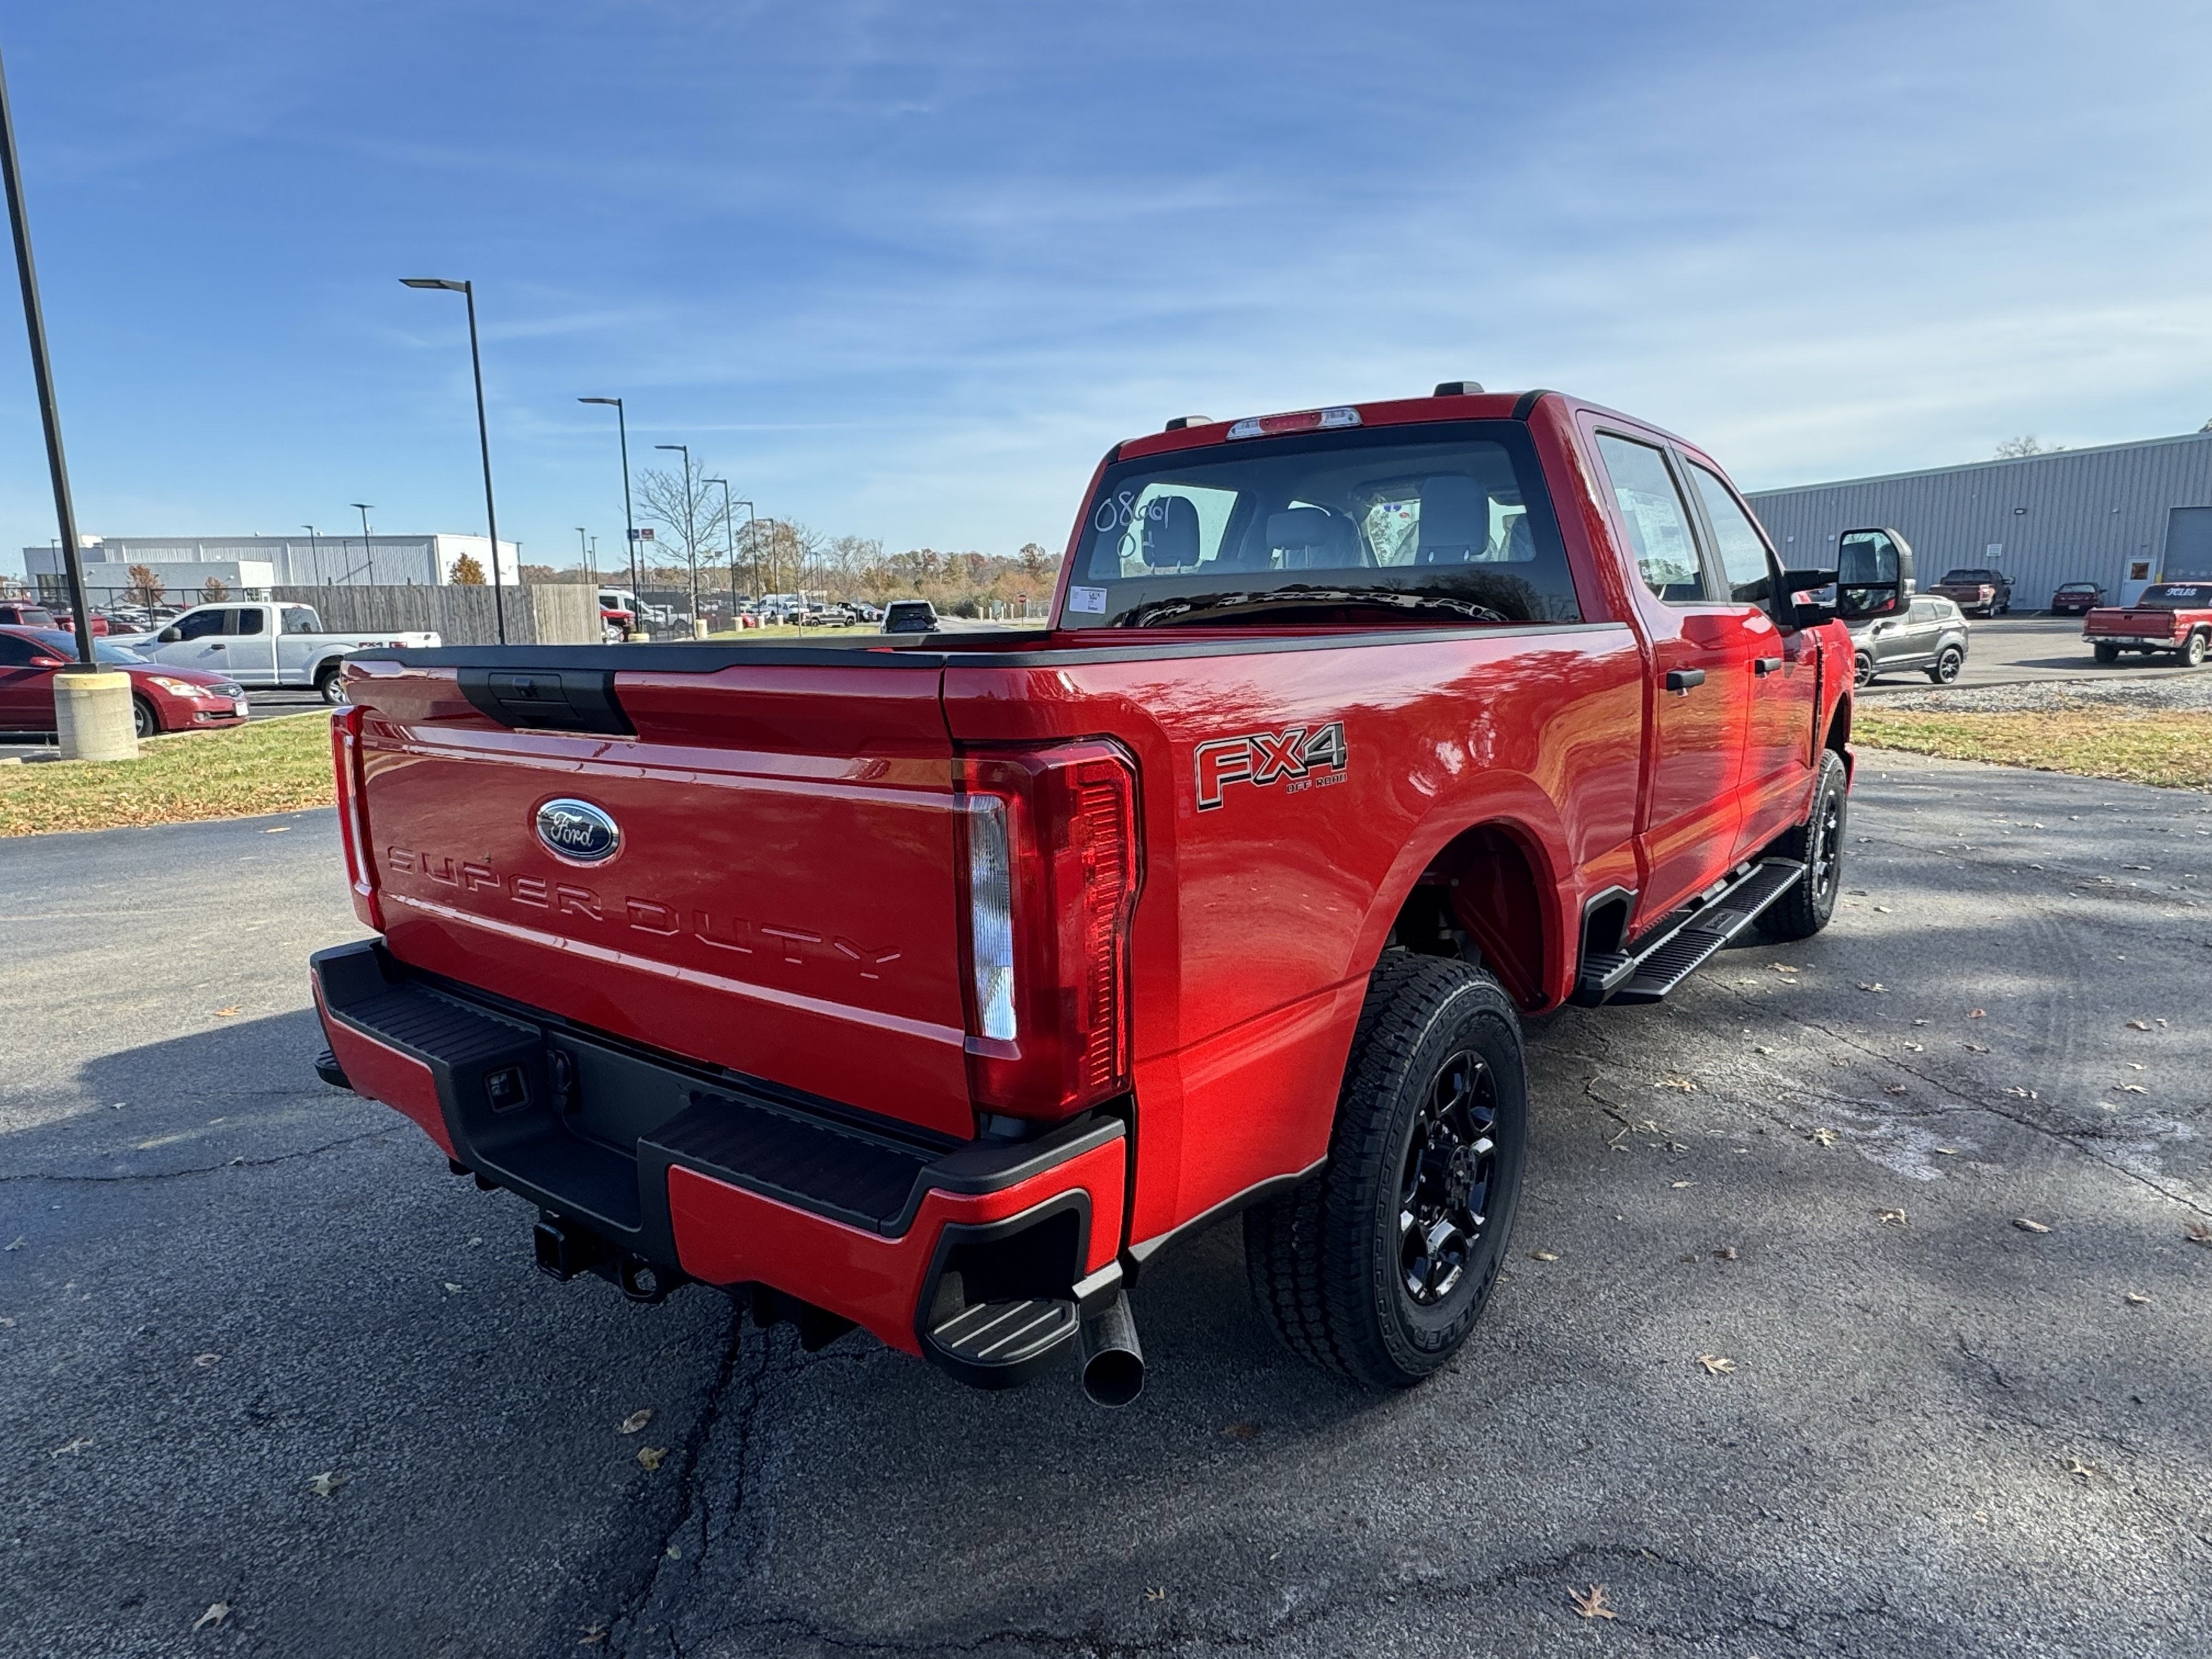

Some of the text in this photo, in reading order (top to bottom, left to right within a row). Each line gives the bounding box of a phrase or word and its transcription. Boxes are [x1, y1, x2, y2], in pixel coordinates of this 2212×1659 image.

[1194, 720, 1348, 813] FX4
[1286, 772, 1347, 794] OFF ROAD
[550, 811, 595, 847] Ford
[387, 845, 901, 979] SUPER DUTY
